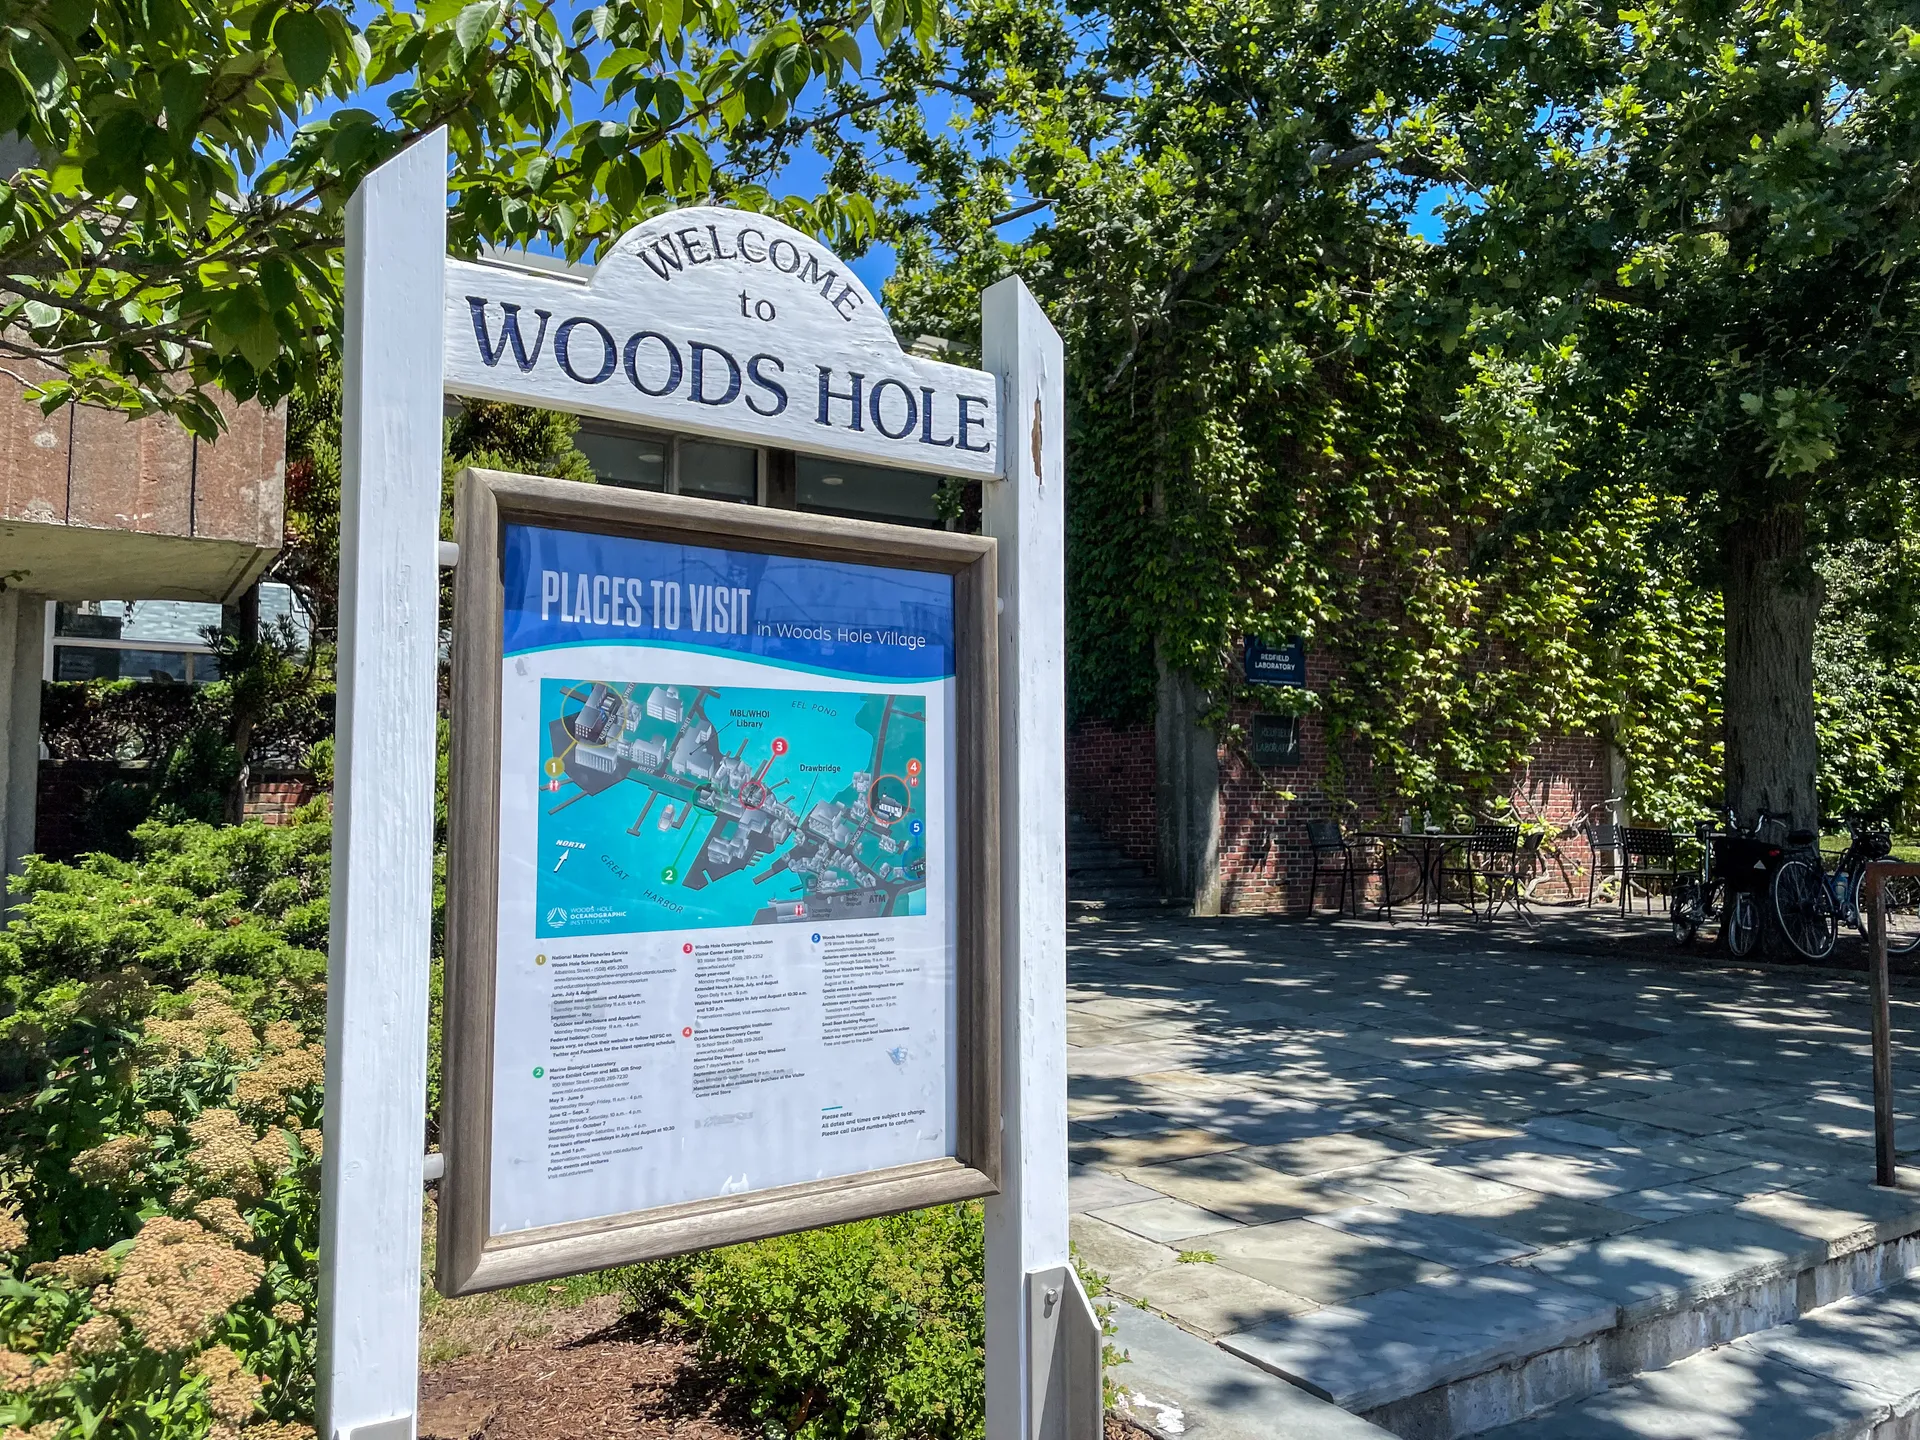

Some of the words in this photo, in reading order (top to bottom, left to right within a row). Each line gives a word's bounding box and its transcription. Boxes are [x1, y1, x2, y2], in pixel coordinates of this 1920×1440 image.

[636, 225, 864, 323] WELCOME
[738, 289, 776, 322] to
[465, 296, 788, 418] WOODS
[815, 364, 991, 454] HOLE
[542, 570, 642, 628] PLACES
[650, 580, 680, 630] TO
[689, 584, 751, 635] VISIT
[757, 621, 772, 638] in
[776, 622, 832, 642] Woods
[838, 628, 872, 644] Hole
[876, 631, 926, 651] Village
[1260, 653, 1290, 662] REDFIELD
[1254, 661, 1296, 671] LABORATORY
[730, 709, 770, 718] MBL/WHOI
[792, 700, 806, 710] EEL
[812, 704, 837, 717] POND
[599, 714, 616, 741] ALBATROSS
[680, 717, 692, 734] STREET
[736, 720, 764, 729] Library
[776, 742, 783, 751] 3
[551, 762, 556, 773] 1
[800, 764, 841, 773] Drawbridge
[910, 762, 917, 771] 4
[662, 773, 680, 783] STREET
[913, 823, 920, 832] 5
[556, 839, 586, 849] NORTH
[665, 870, 673, 880] 2
[601, 854, 630, 881] GREAT
[643, 889, 684, 914] HARBOR
[869, 894, 886, 903] ATM
